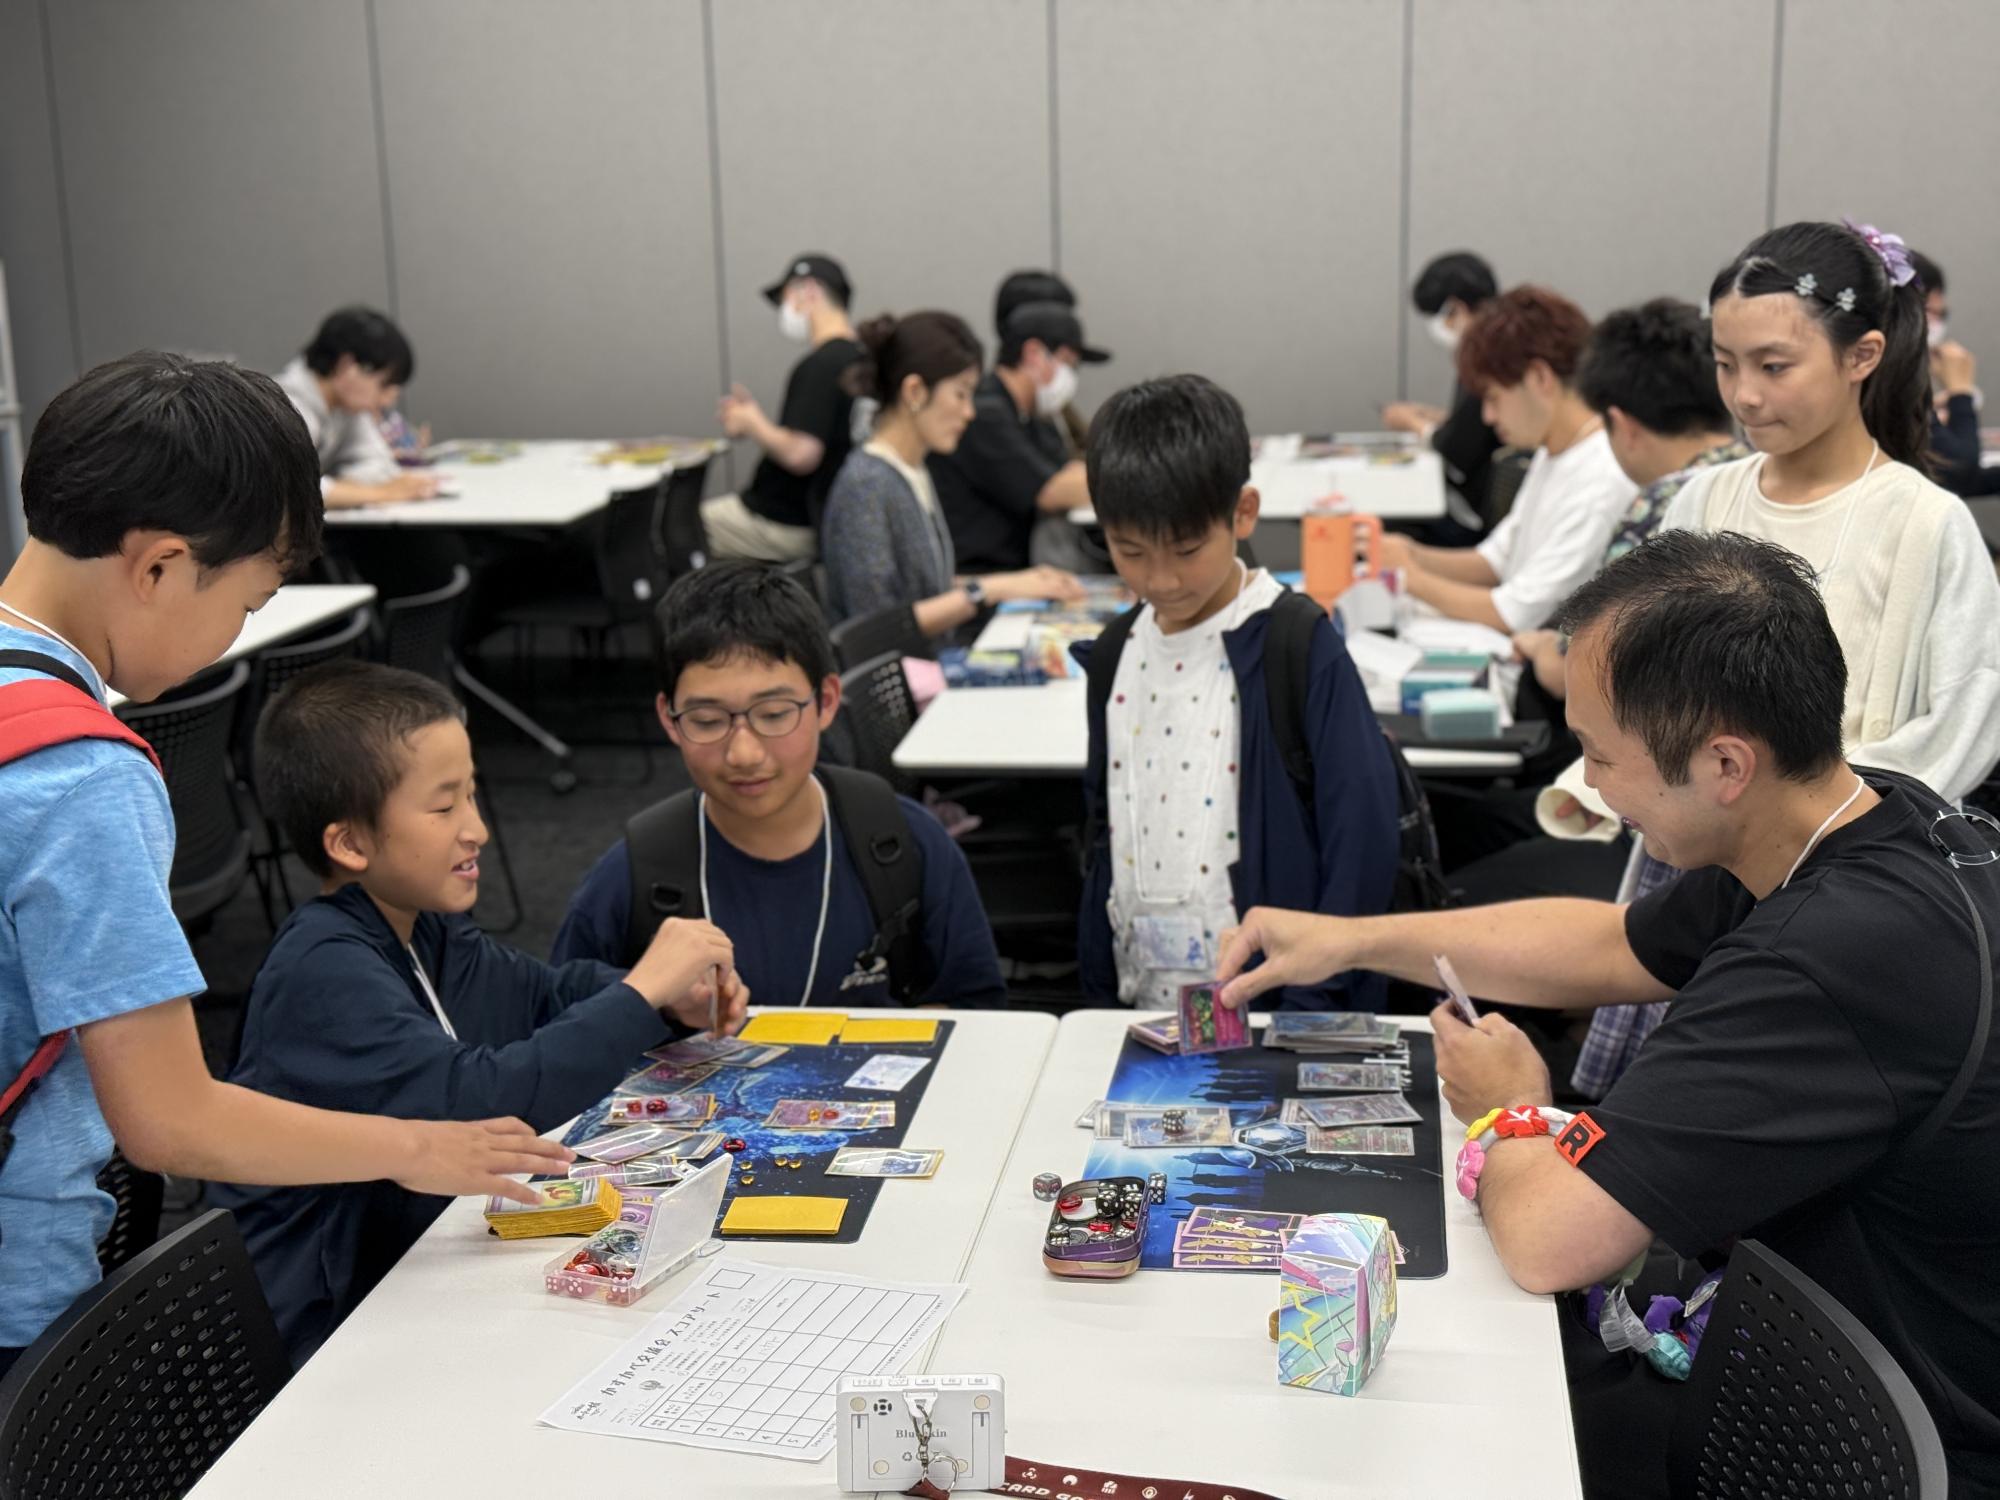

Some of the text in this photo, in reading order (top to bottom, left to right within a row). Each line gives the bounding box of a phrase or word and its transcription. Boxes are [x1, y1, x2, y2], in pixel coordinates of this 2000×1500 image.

[1559, 1122, 1590, 1159] R
[666, 1292, 720, 1337] スコアシート
[896, 1429, 947, 1438] Blukin
